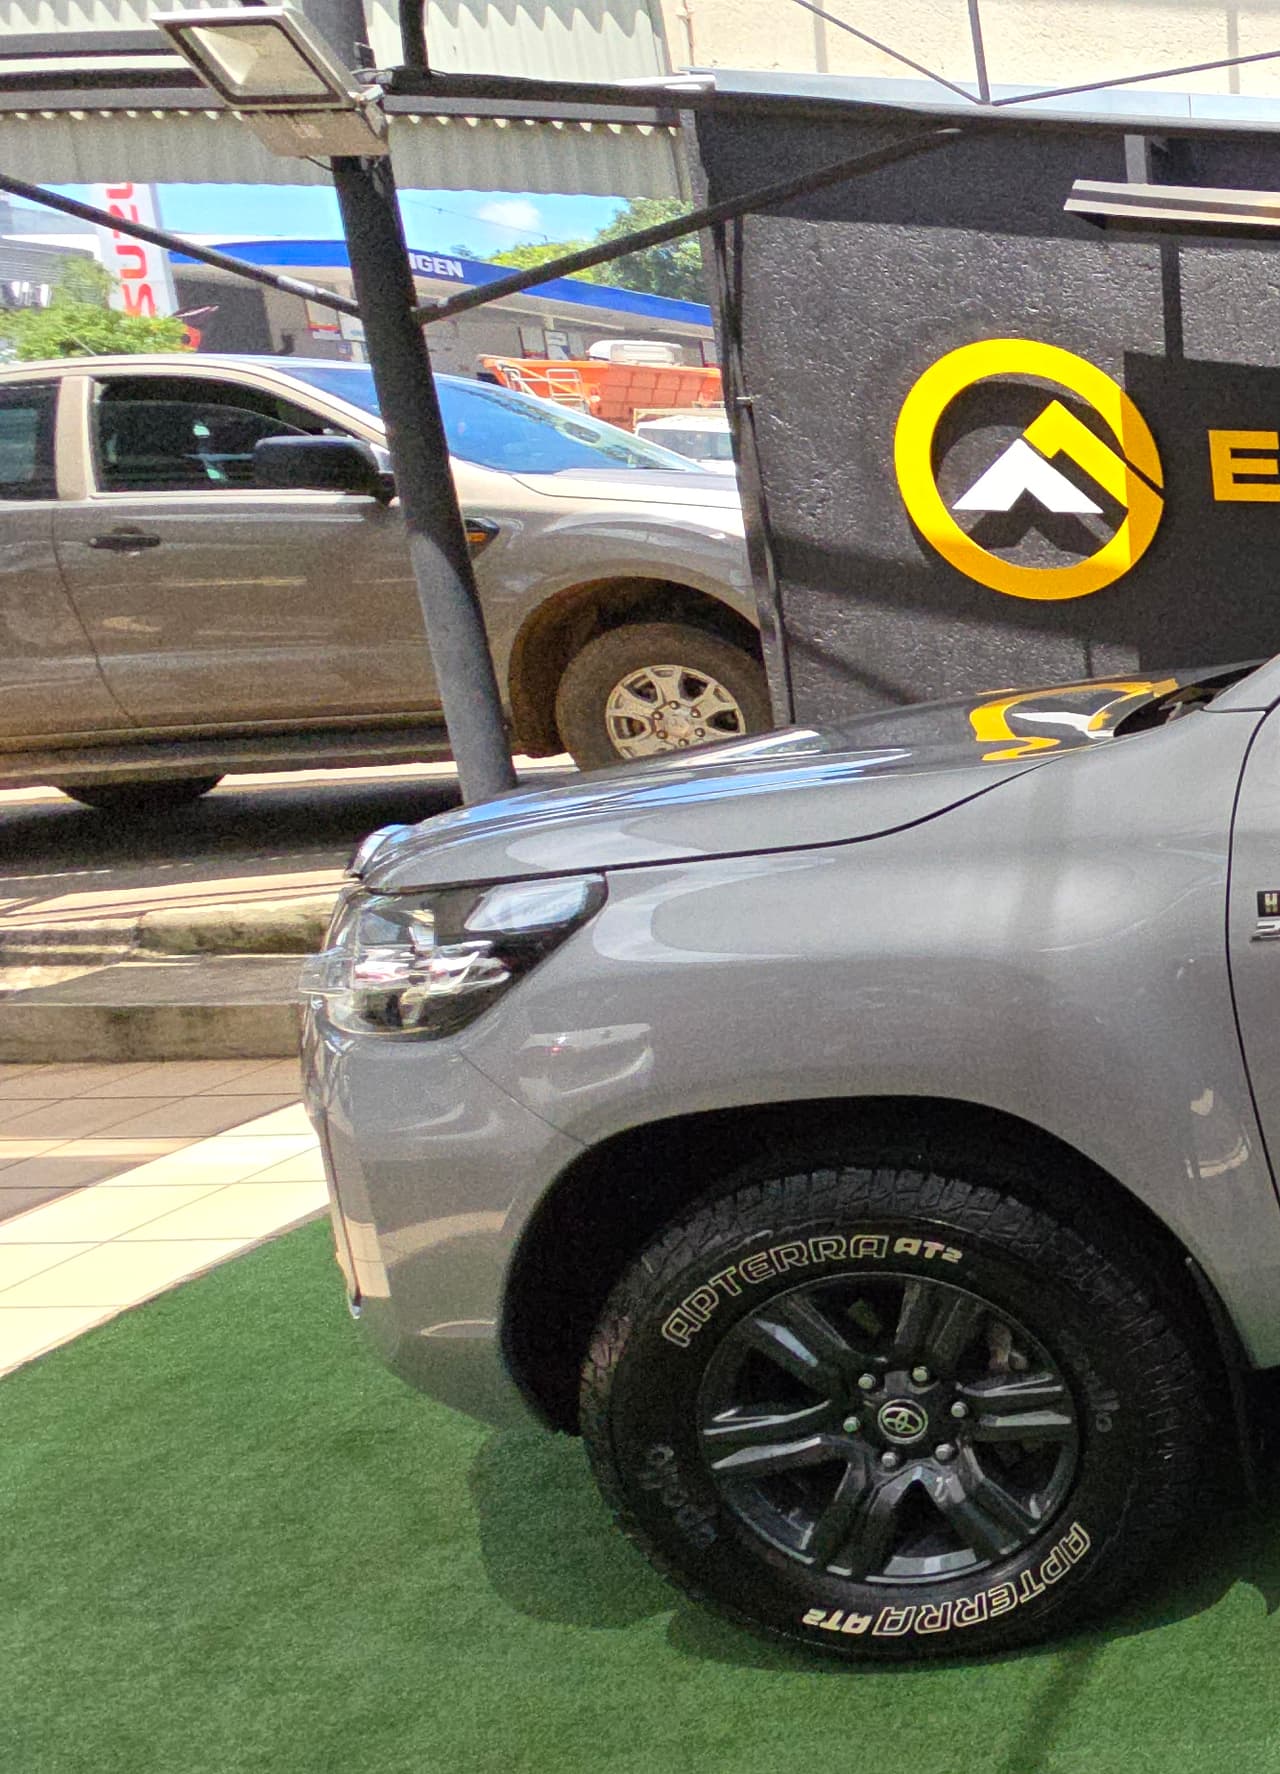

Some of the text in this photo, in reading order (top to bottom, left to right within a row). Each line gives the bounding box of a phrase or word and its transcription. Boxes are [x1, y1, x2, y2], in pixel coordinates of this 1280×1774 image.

[660, 1234, 964, 1348] APTERRA AT2
[801, 1521, 1092, 1637] APTERRA AT2
